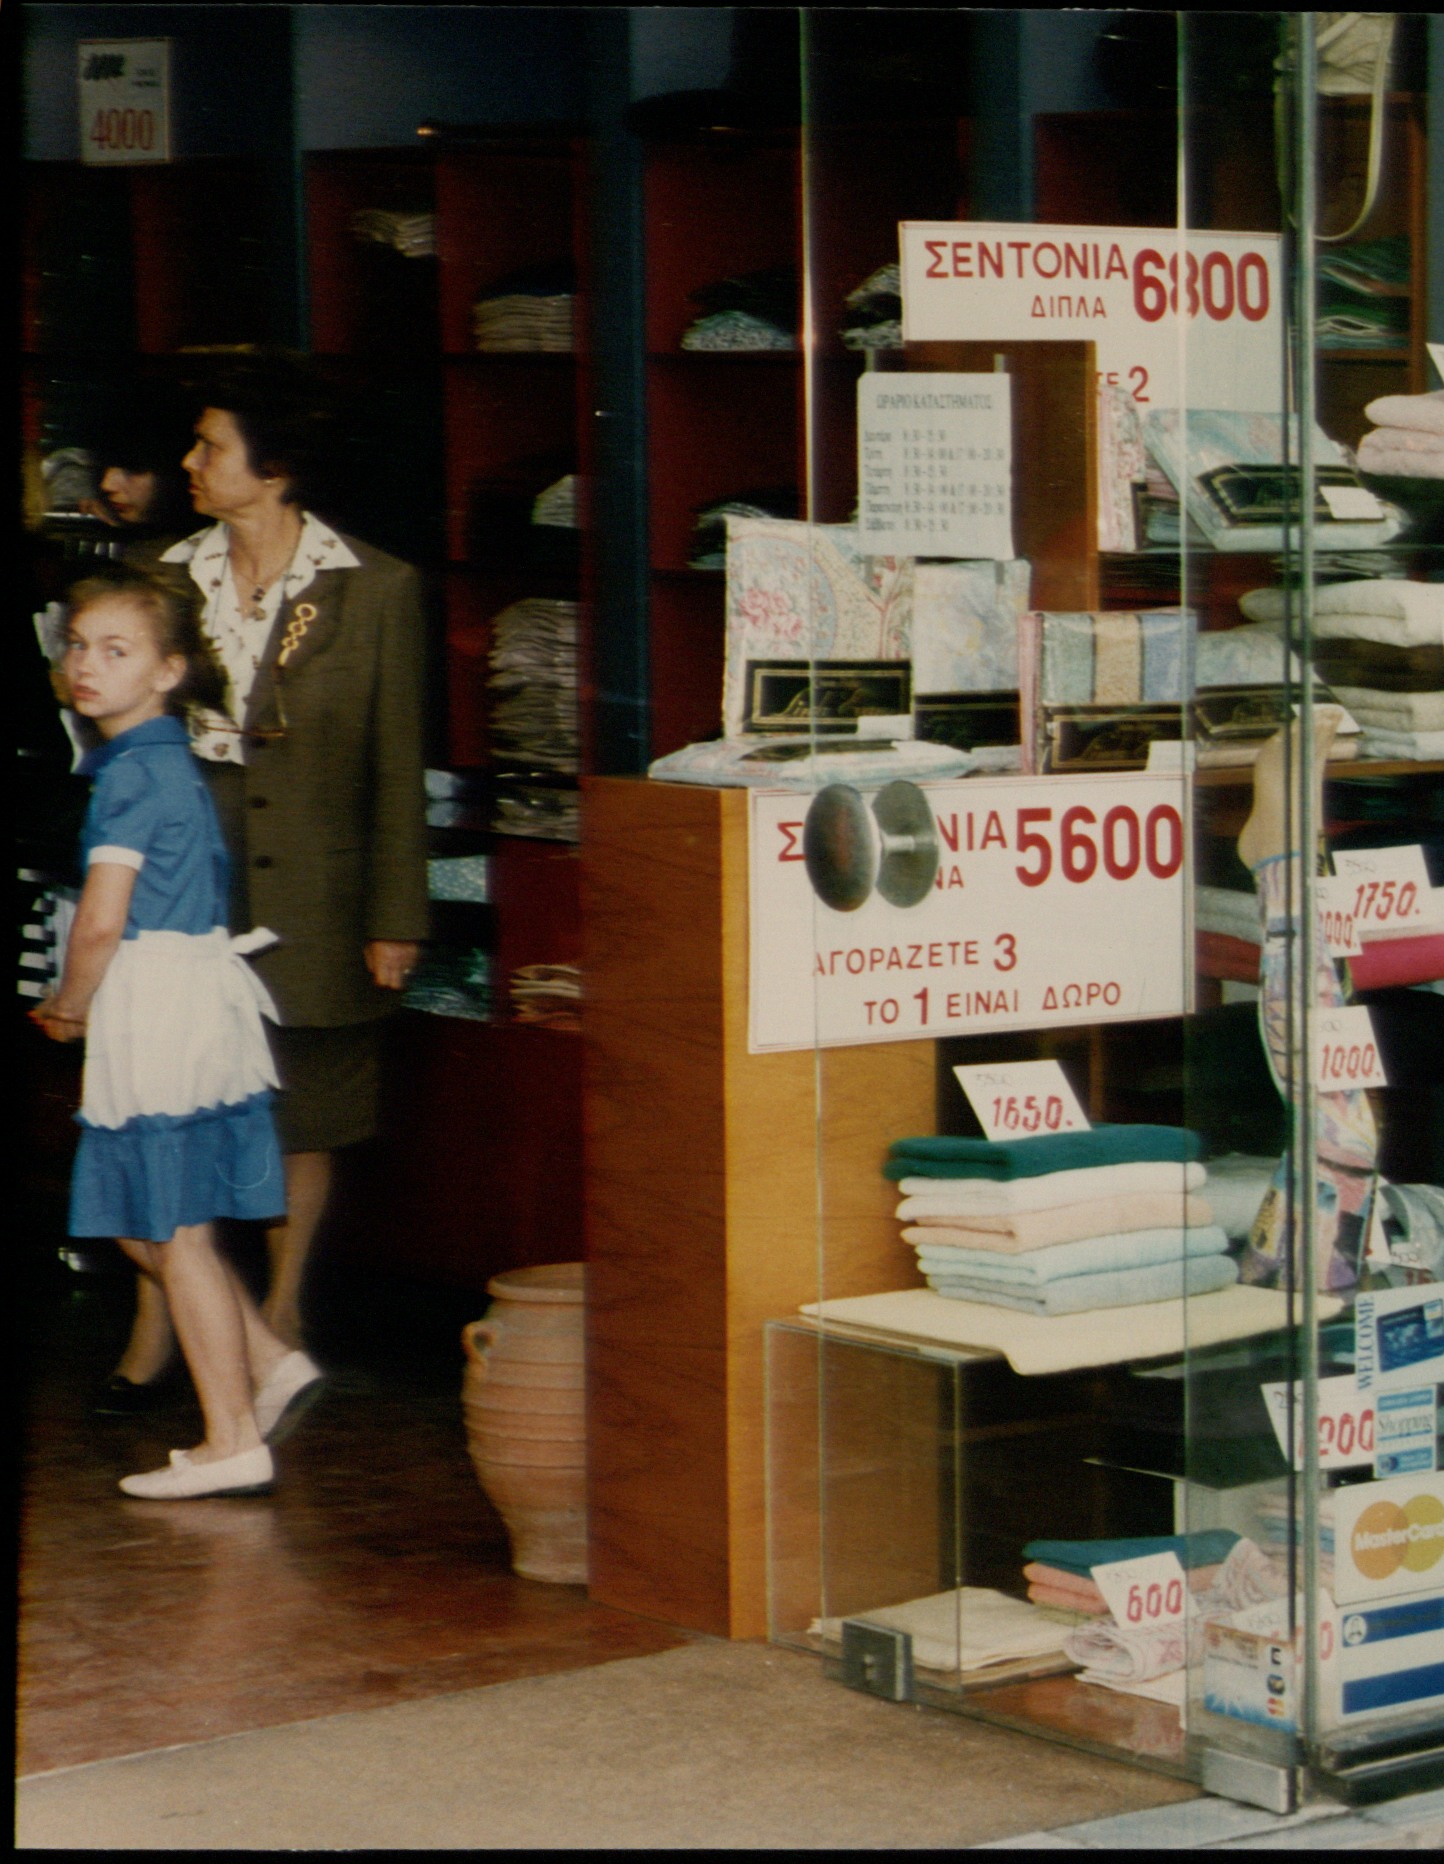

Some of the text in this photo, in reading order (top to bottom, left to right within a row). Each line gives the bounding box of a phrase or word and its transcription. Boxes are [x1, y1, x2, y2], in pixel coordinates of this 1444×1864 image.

[90, 108, 155, 152] 4000
[925, 240, 1271, 323] ΣΕΝΤΟΝΙΑ 6800
[1030, 294, 1108, 319] ΔΙΠΛΑ
[1128, 365, 1151, 403] 2
[1016, 803, 1184, 888] 5600
[993, 933, 1017, 972] 3
[863, 981, 1122, 1025] ΤΟ 1 ΕΙΝΑΙ ΔΩΡΟ
[1357, 1297, 1374, 1390] WELCOME
[1127, 1578, 1184, 1623] 600
